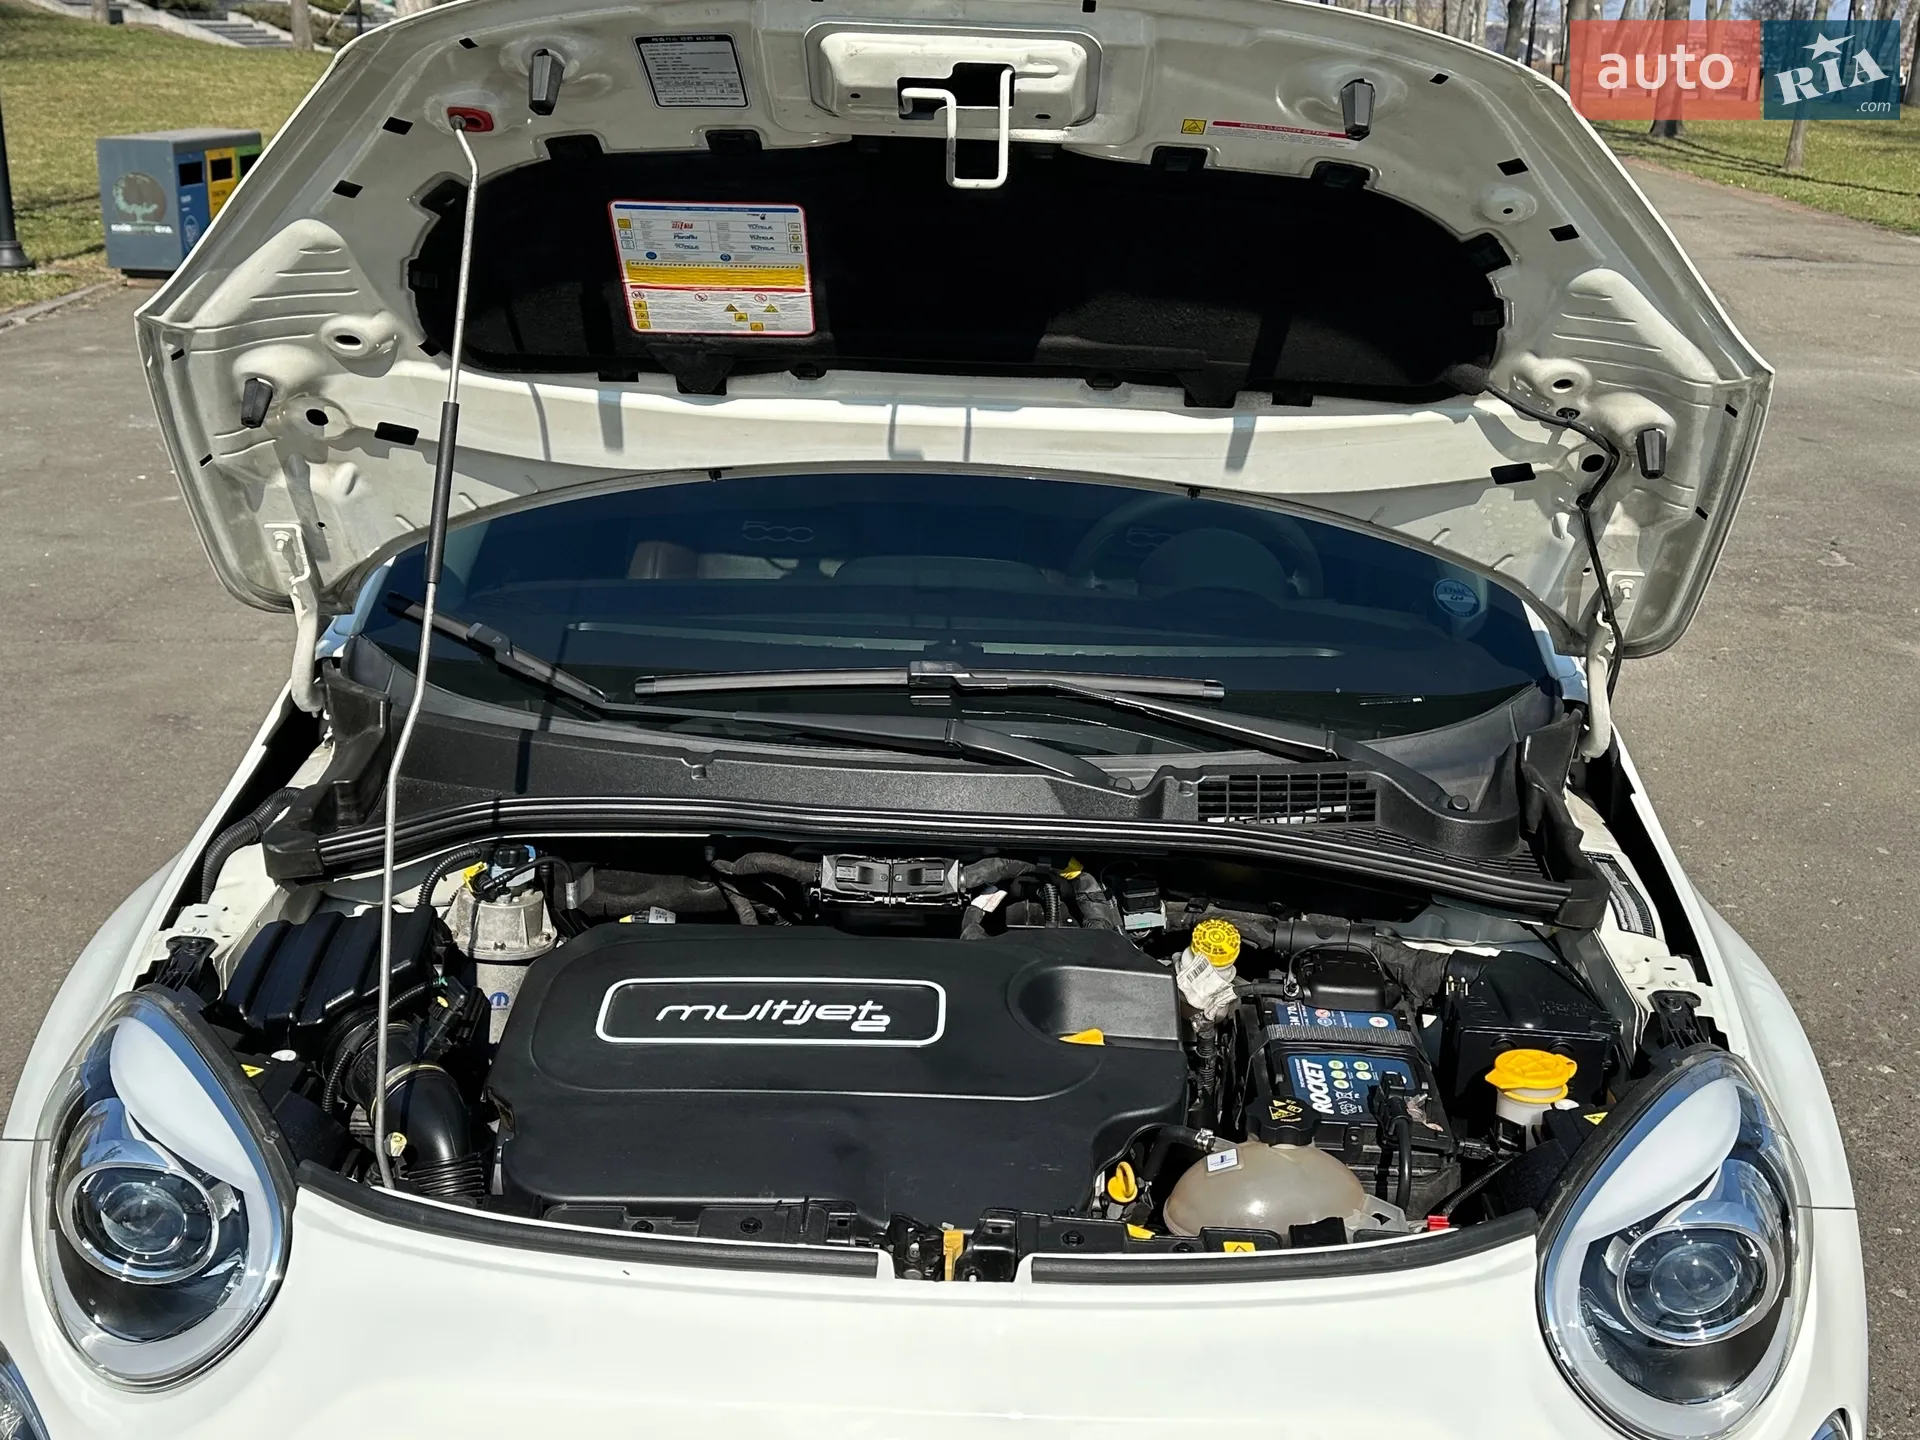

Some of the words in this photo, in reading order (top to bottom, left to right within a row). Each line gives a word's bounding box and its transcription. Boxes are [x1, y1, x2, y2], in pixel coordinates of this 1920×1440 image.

[742, 520, 815, 542] 500
[1126, 527, 1175, 547] 50
[655, 1000, 884, 1025] multijet
[1301, 1058, 1335, 1115] ROCKET
